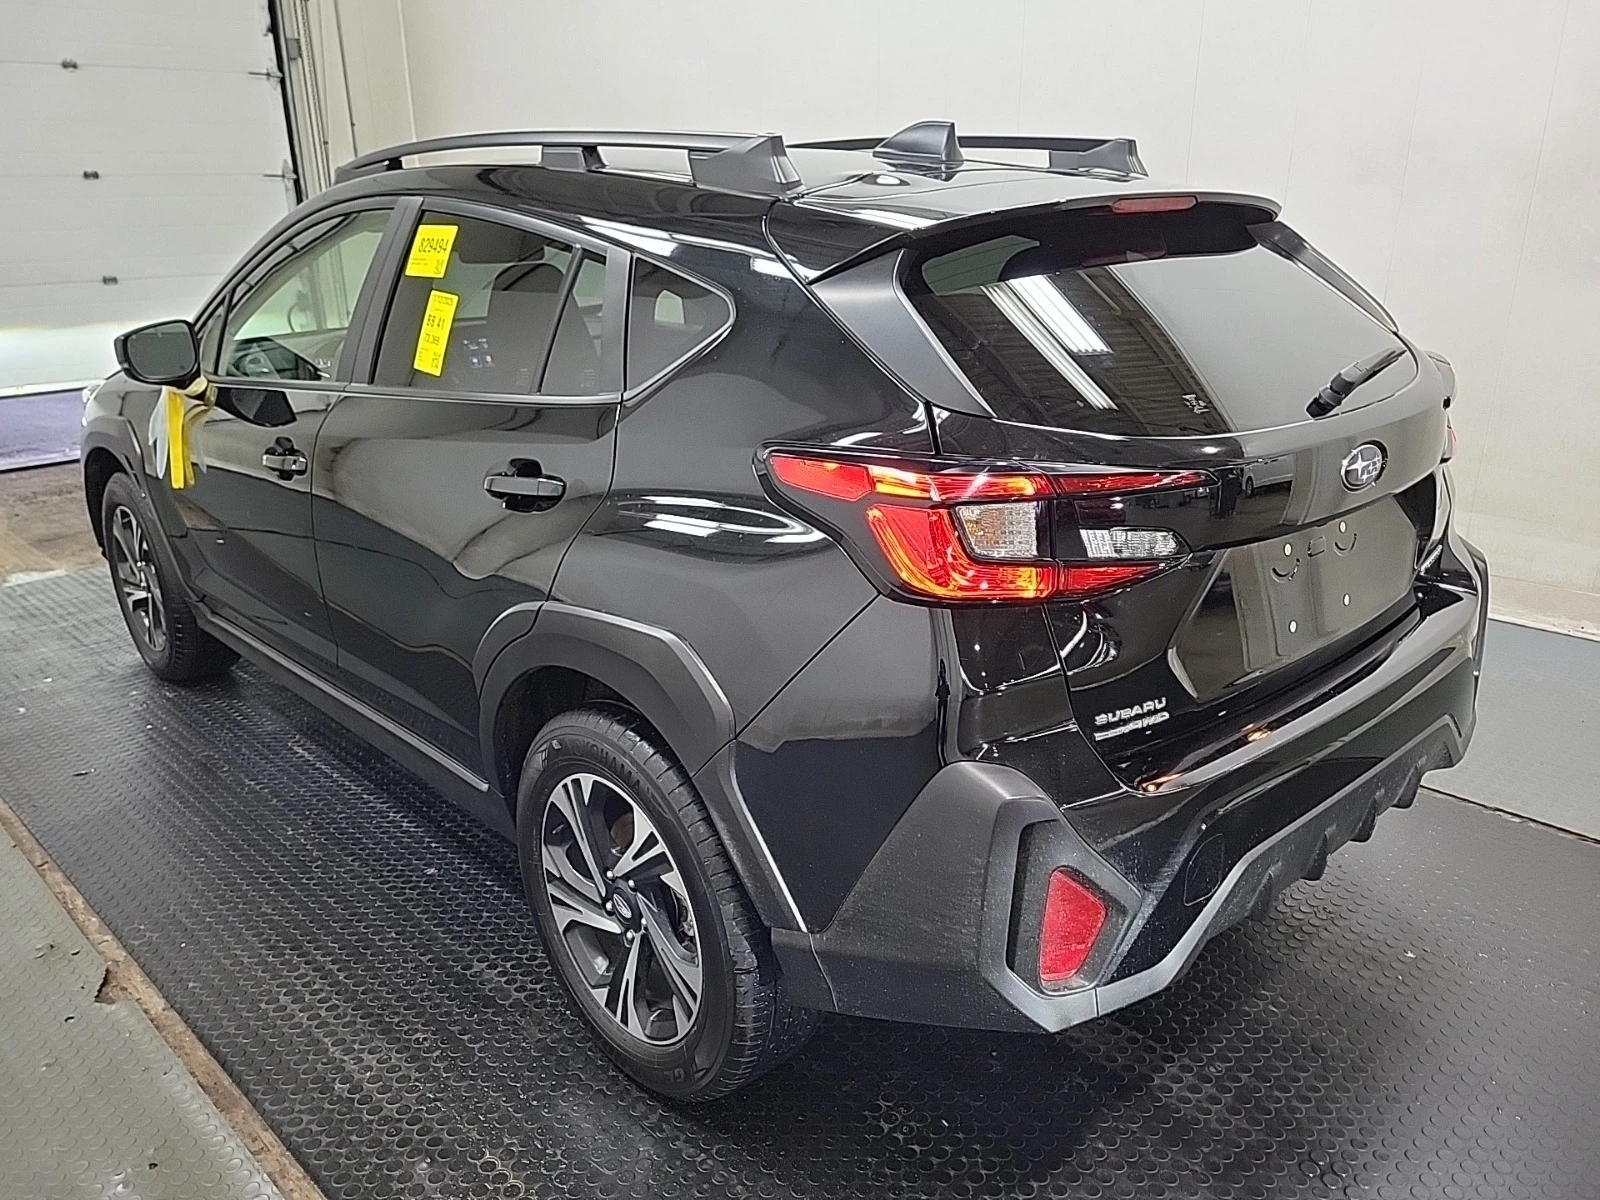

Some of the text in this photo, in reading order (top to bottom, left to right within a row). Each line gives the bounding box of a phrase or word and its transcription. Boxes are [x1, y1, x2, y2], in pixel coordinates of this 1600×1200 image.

[418, 237, 450, 254] 829494
[1094, 696, 1167, 727] SUBARU
[564, 737, 642, 798] OOHAMA
